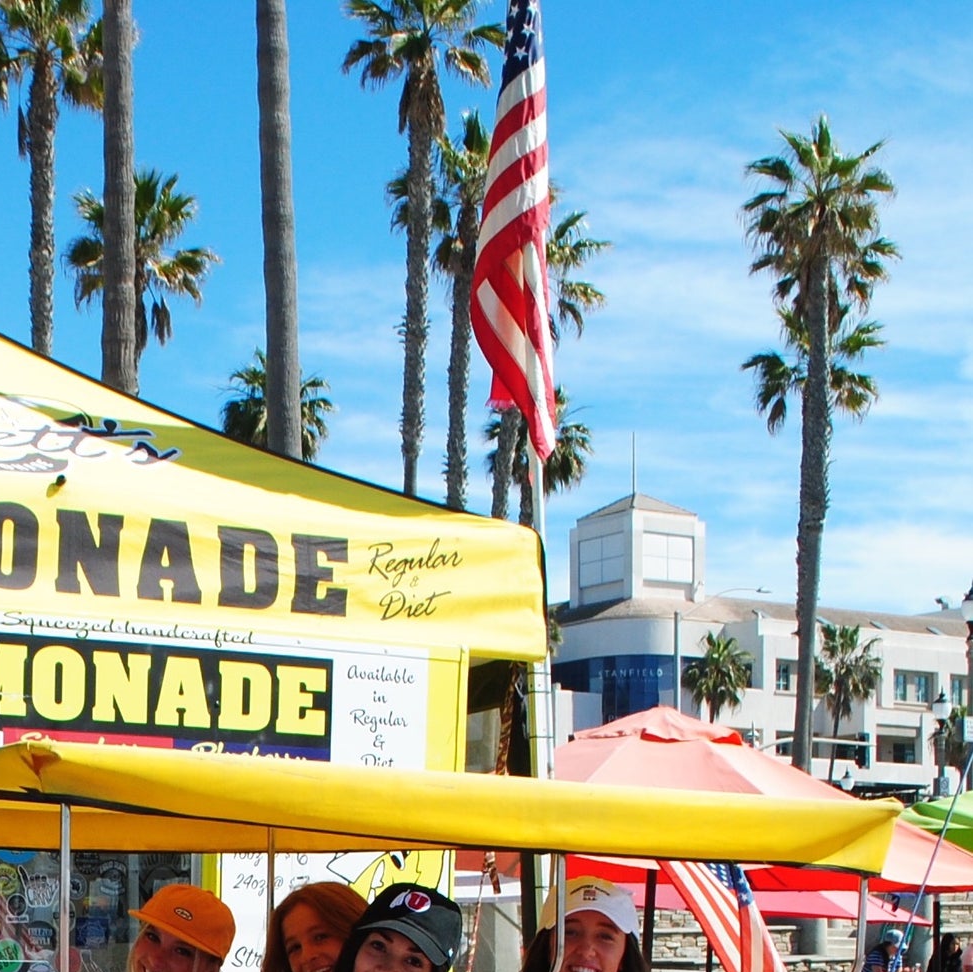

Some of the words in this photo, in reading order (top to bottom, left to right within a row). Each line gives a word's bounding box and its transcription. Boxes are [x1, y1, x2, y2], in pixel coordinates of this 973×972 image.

[367, 537, 463, 588] Regular
[378, 590, 453, 621] Diet
[3, 610, 115, 640] Squeezed
[123, 619, 256, 648] handcrafted
[346, 664, 415, 685] Available
[598, 667, 664, 680] STANFIELD
[372, 688, 388, 704] in
[349, 708, 409, 733] Regular
[372, 733, 386, 750] &
[233, 873, 268, 897] 24oz
[408, 891, 428, 909] U
